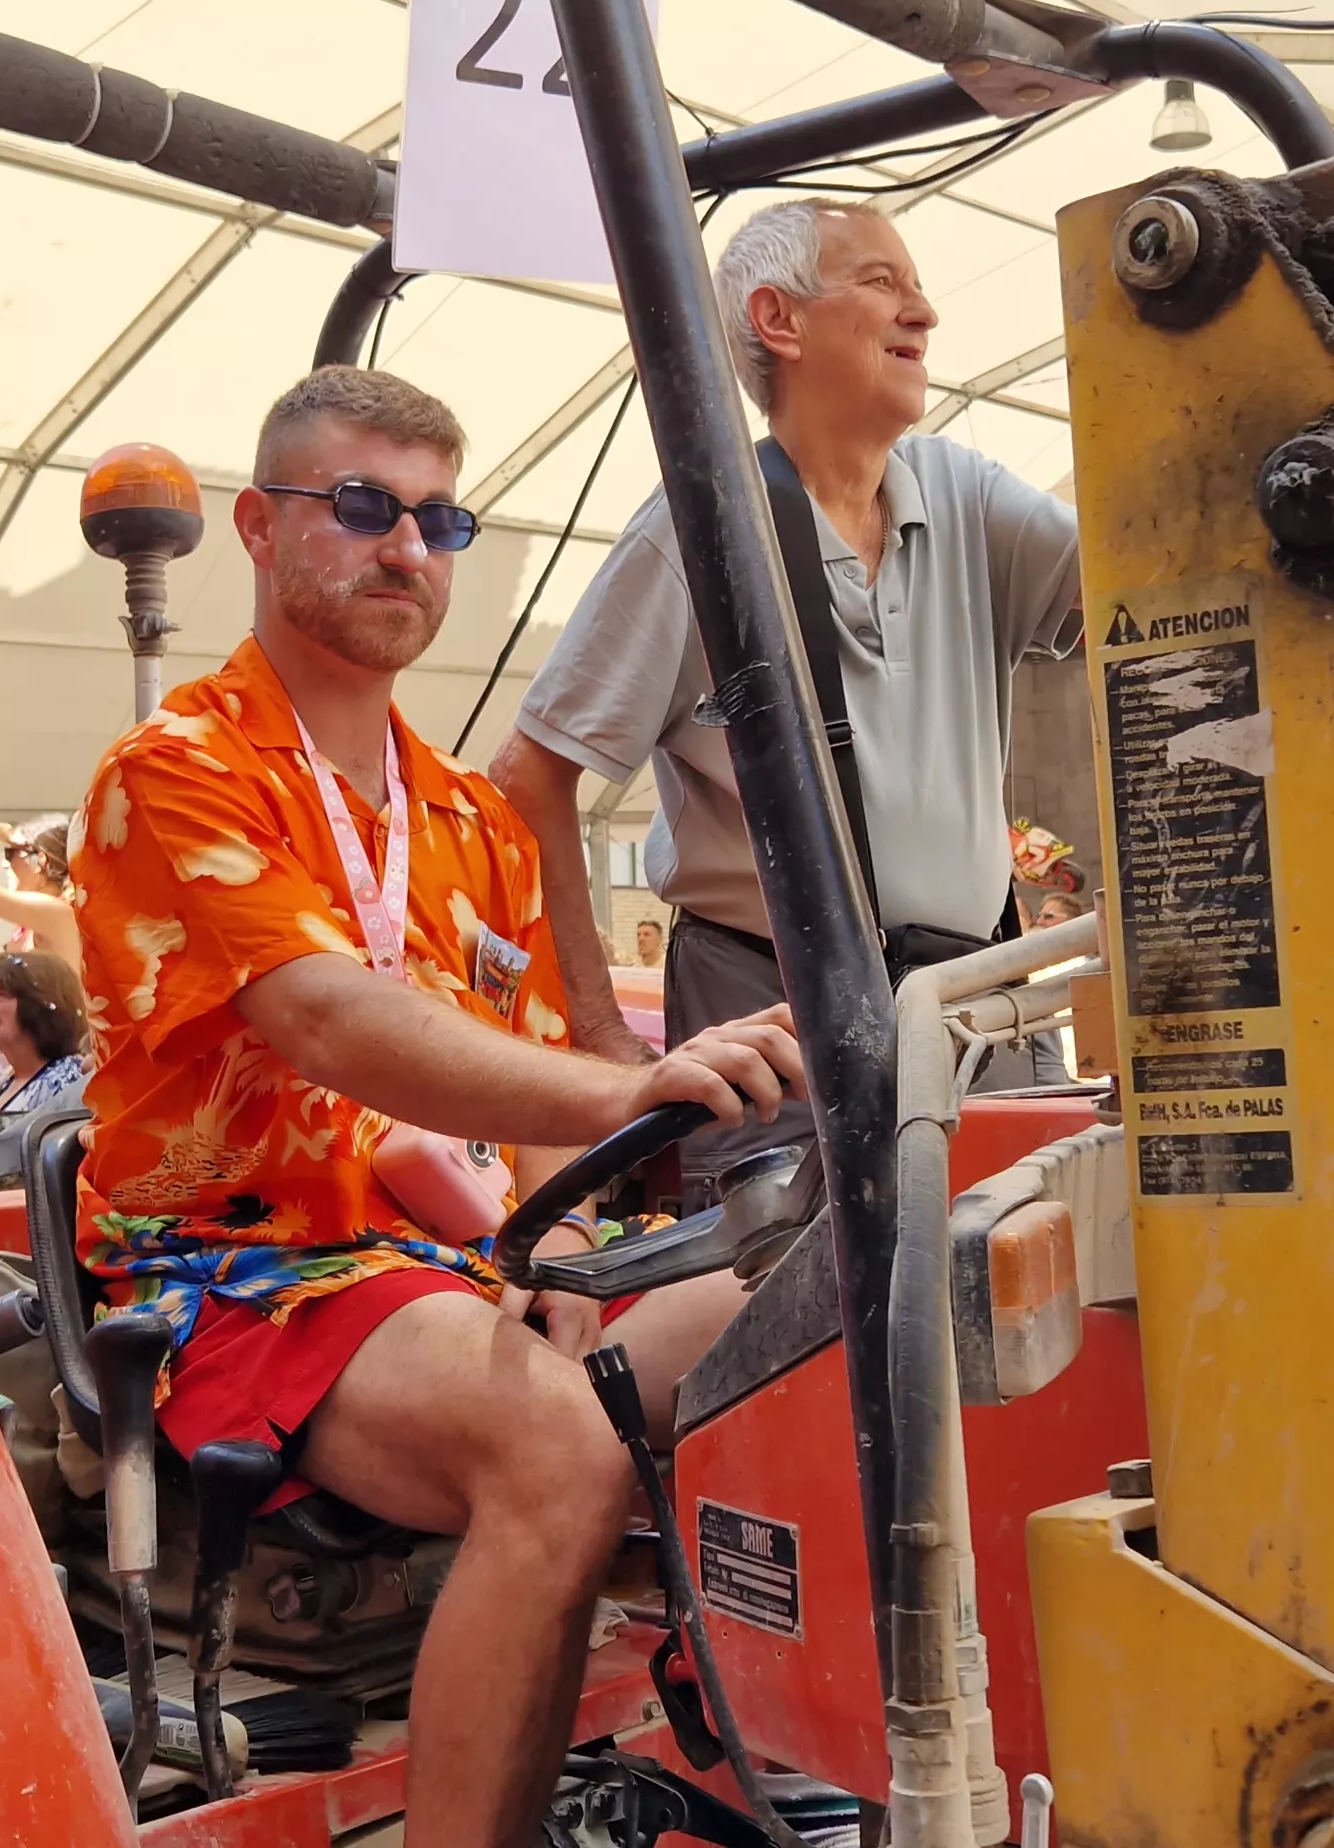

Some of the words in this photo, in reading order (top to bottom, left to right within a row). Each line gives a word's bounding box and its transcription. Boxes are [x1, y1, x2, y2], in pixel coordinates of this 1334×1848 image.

[1149, 604, 1250, 641] ATENCION
[1166, 1021, 1244, 1043] ENGRASE
[1243, 1097, 1284, 1118] PALAS
[741, 1520, 774, 1558] SAME
